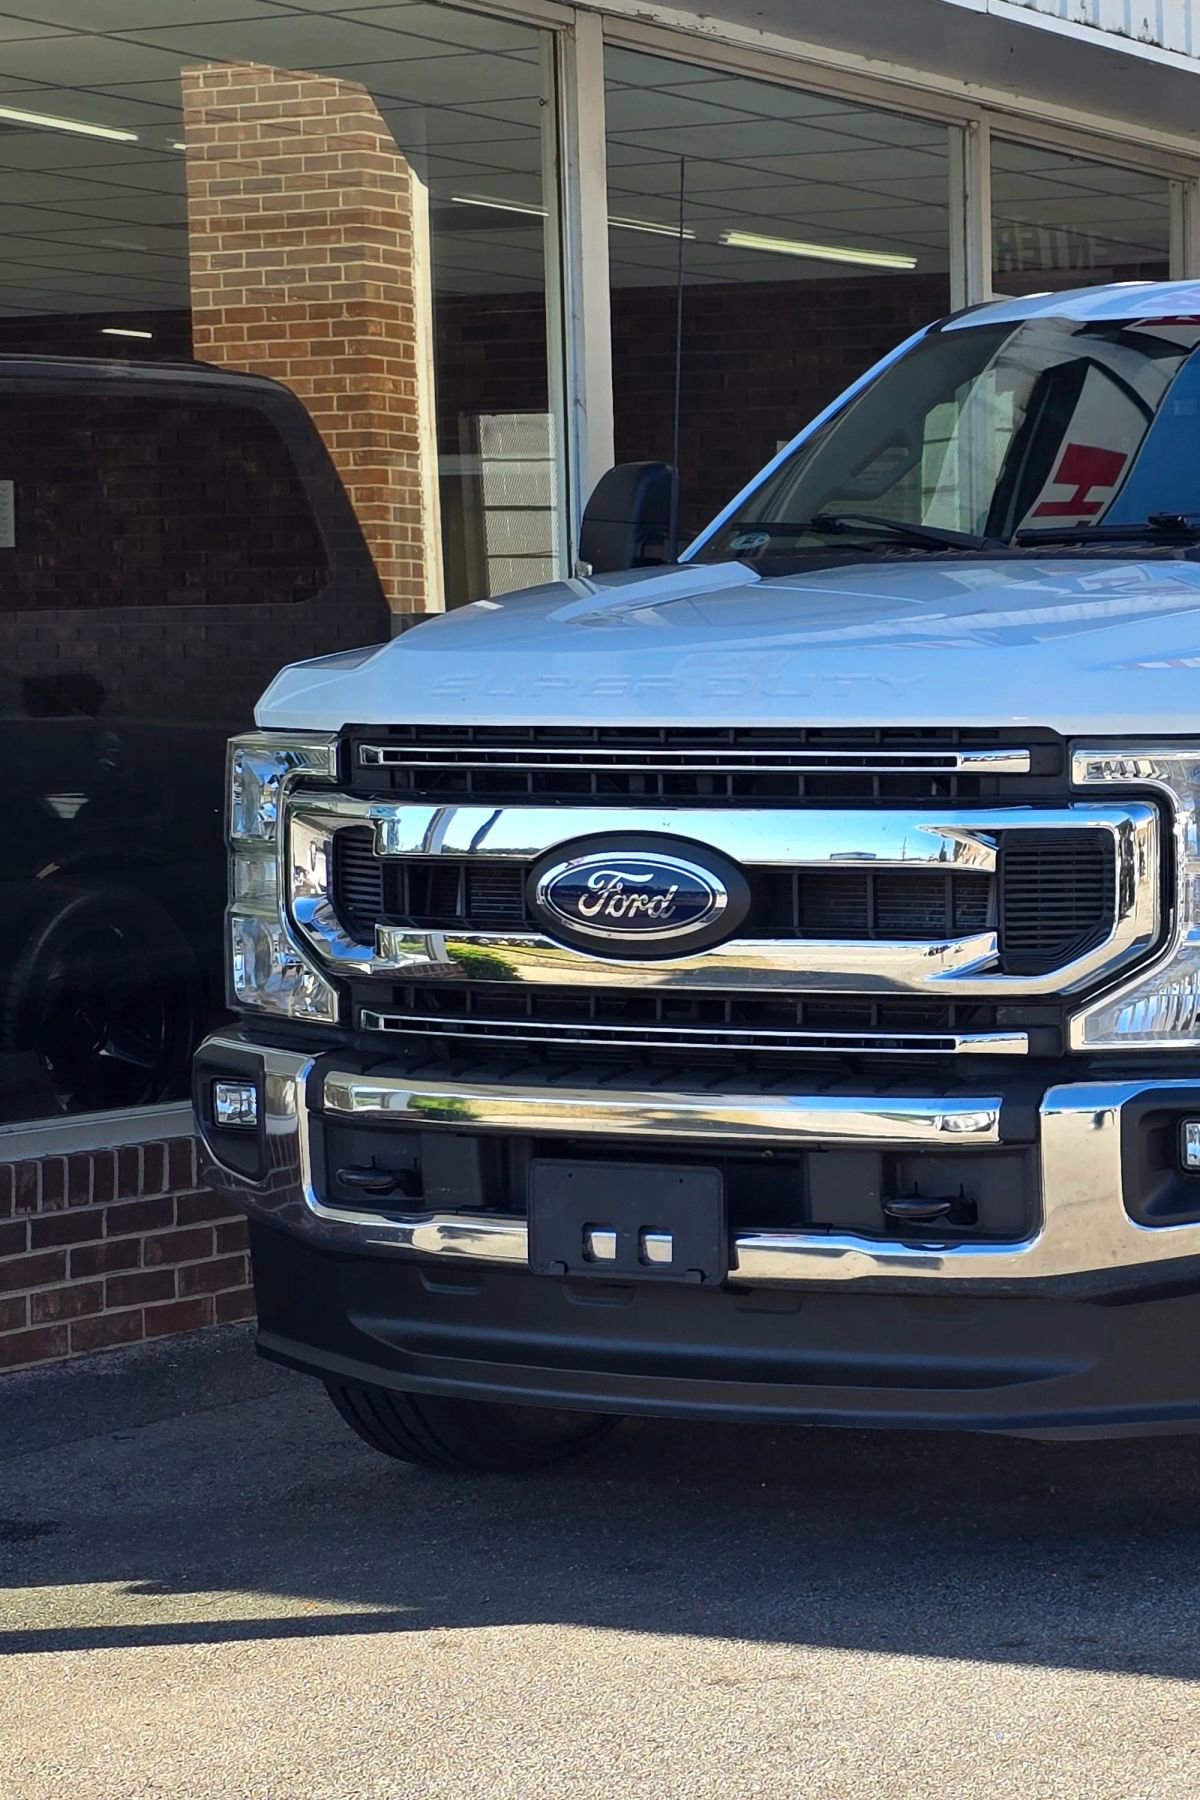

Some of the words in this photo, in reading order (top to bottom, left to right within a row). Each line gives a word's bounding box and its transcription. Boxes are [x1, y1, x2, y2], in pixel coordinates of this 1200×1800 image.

[431, 674, 685, 698] SUPER
[700, 673, 928, 698] DUTY
[578, 870, 679, 919] Ford
